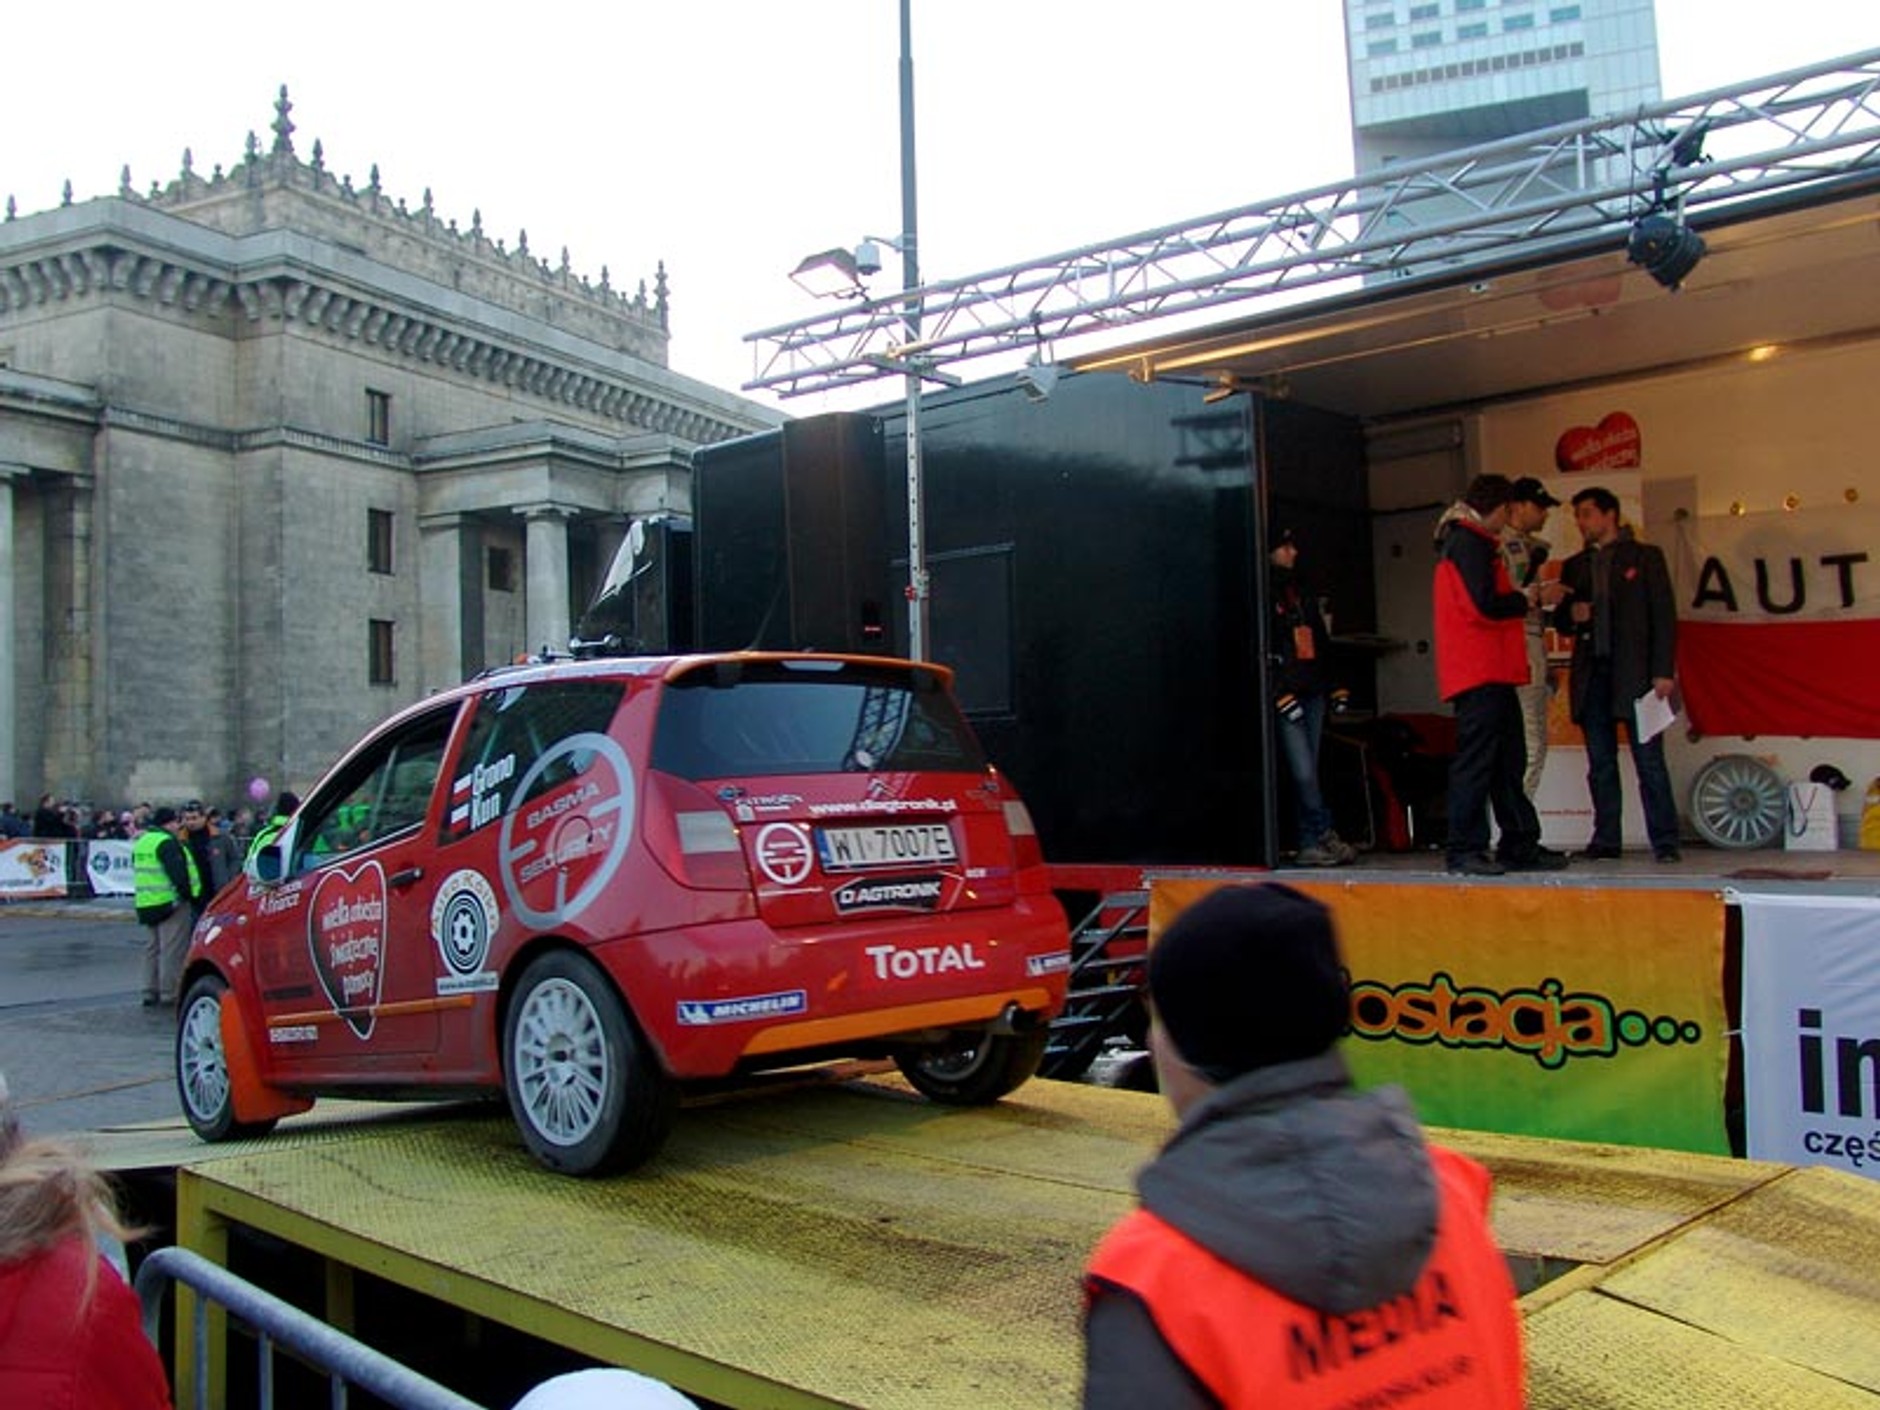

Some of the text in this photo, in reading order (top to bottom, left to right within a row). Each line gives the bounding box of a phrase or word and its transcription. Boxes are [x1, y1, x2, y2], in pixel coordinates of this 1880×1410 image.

[873, 827, 951, 860] 7007E
[712, 994, 801, 1017] MICHELIN
[1286, 1270, 1465, 1383] MEDIA
